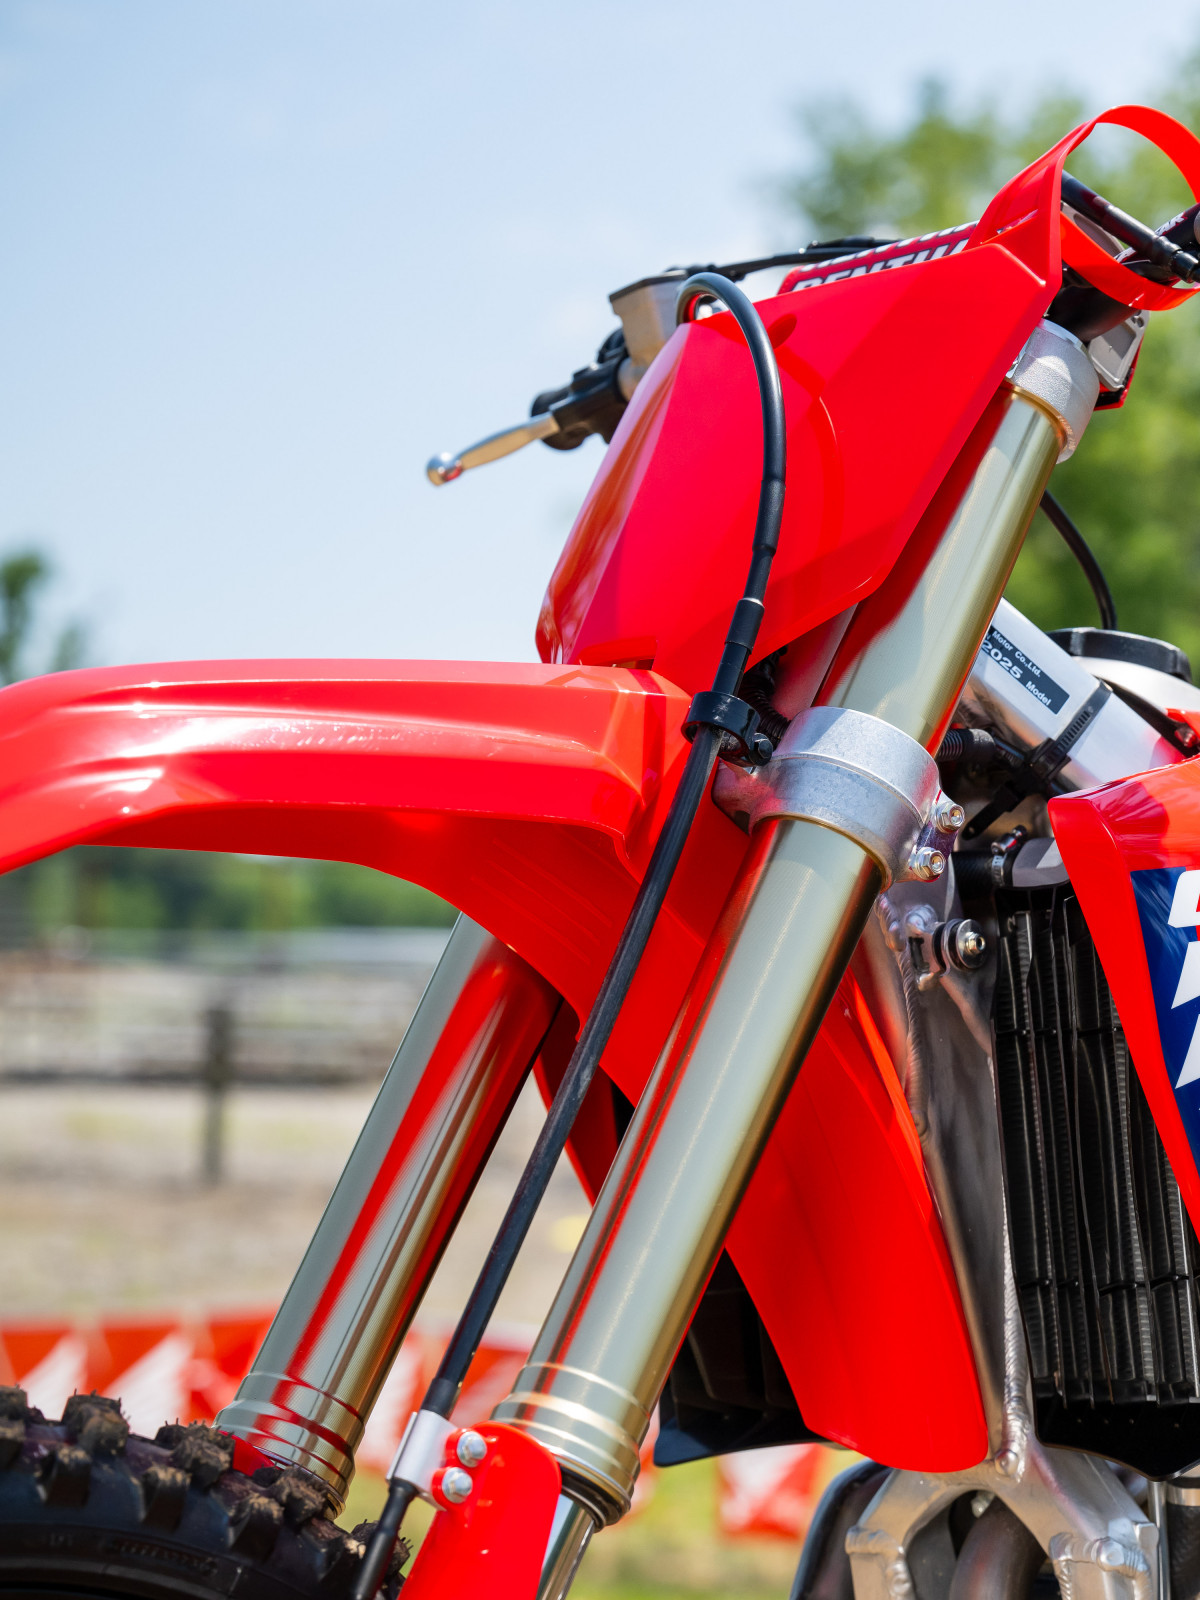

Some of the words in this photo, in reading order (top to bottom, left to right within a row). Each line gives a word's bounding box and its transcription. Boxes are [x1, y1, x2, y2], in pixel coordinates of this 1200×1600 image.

[992, 631, 1013, 651] Motor
[981, 640, 1023, 679] 2025
[1026, 681, 1052, 705] Model
